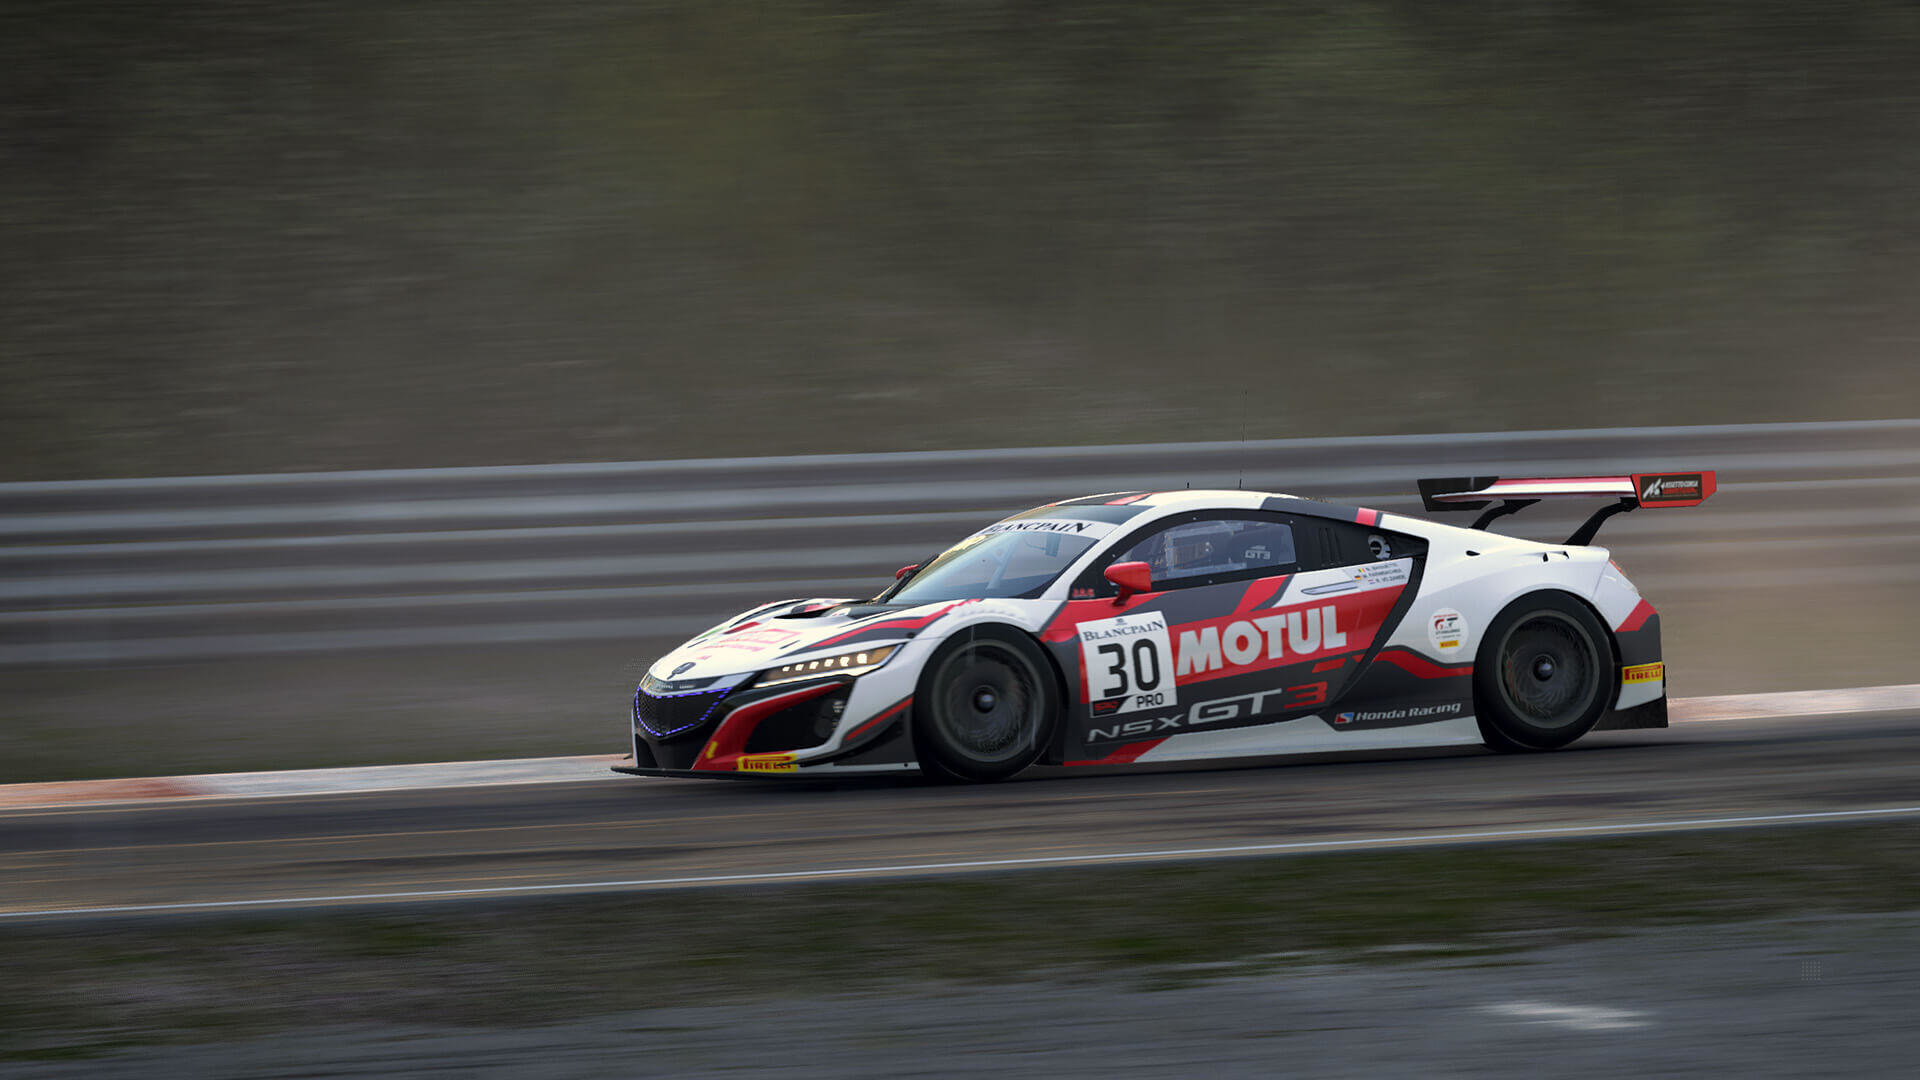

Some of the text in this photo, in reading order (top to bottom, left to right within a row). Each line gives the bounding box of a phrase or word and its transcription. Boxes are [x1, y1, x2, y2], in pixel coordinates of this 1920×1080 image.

[1245, 550, 1270, 560] GT3
[1083, 620, 1165, 641] BLANCPAIN
[1176, 605, 1347, 677] MOTUL
[1097, 638, 1161, 698] 30
[1624, 665, 1662, 680] PIRELLI
[1136, 693, 1164, 708] PRO
[1355, 703, 1462, 721] Honda Racing
[1087, 713, 1184, 742] NSX
